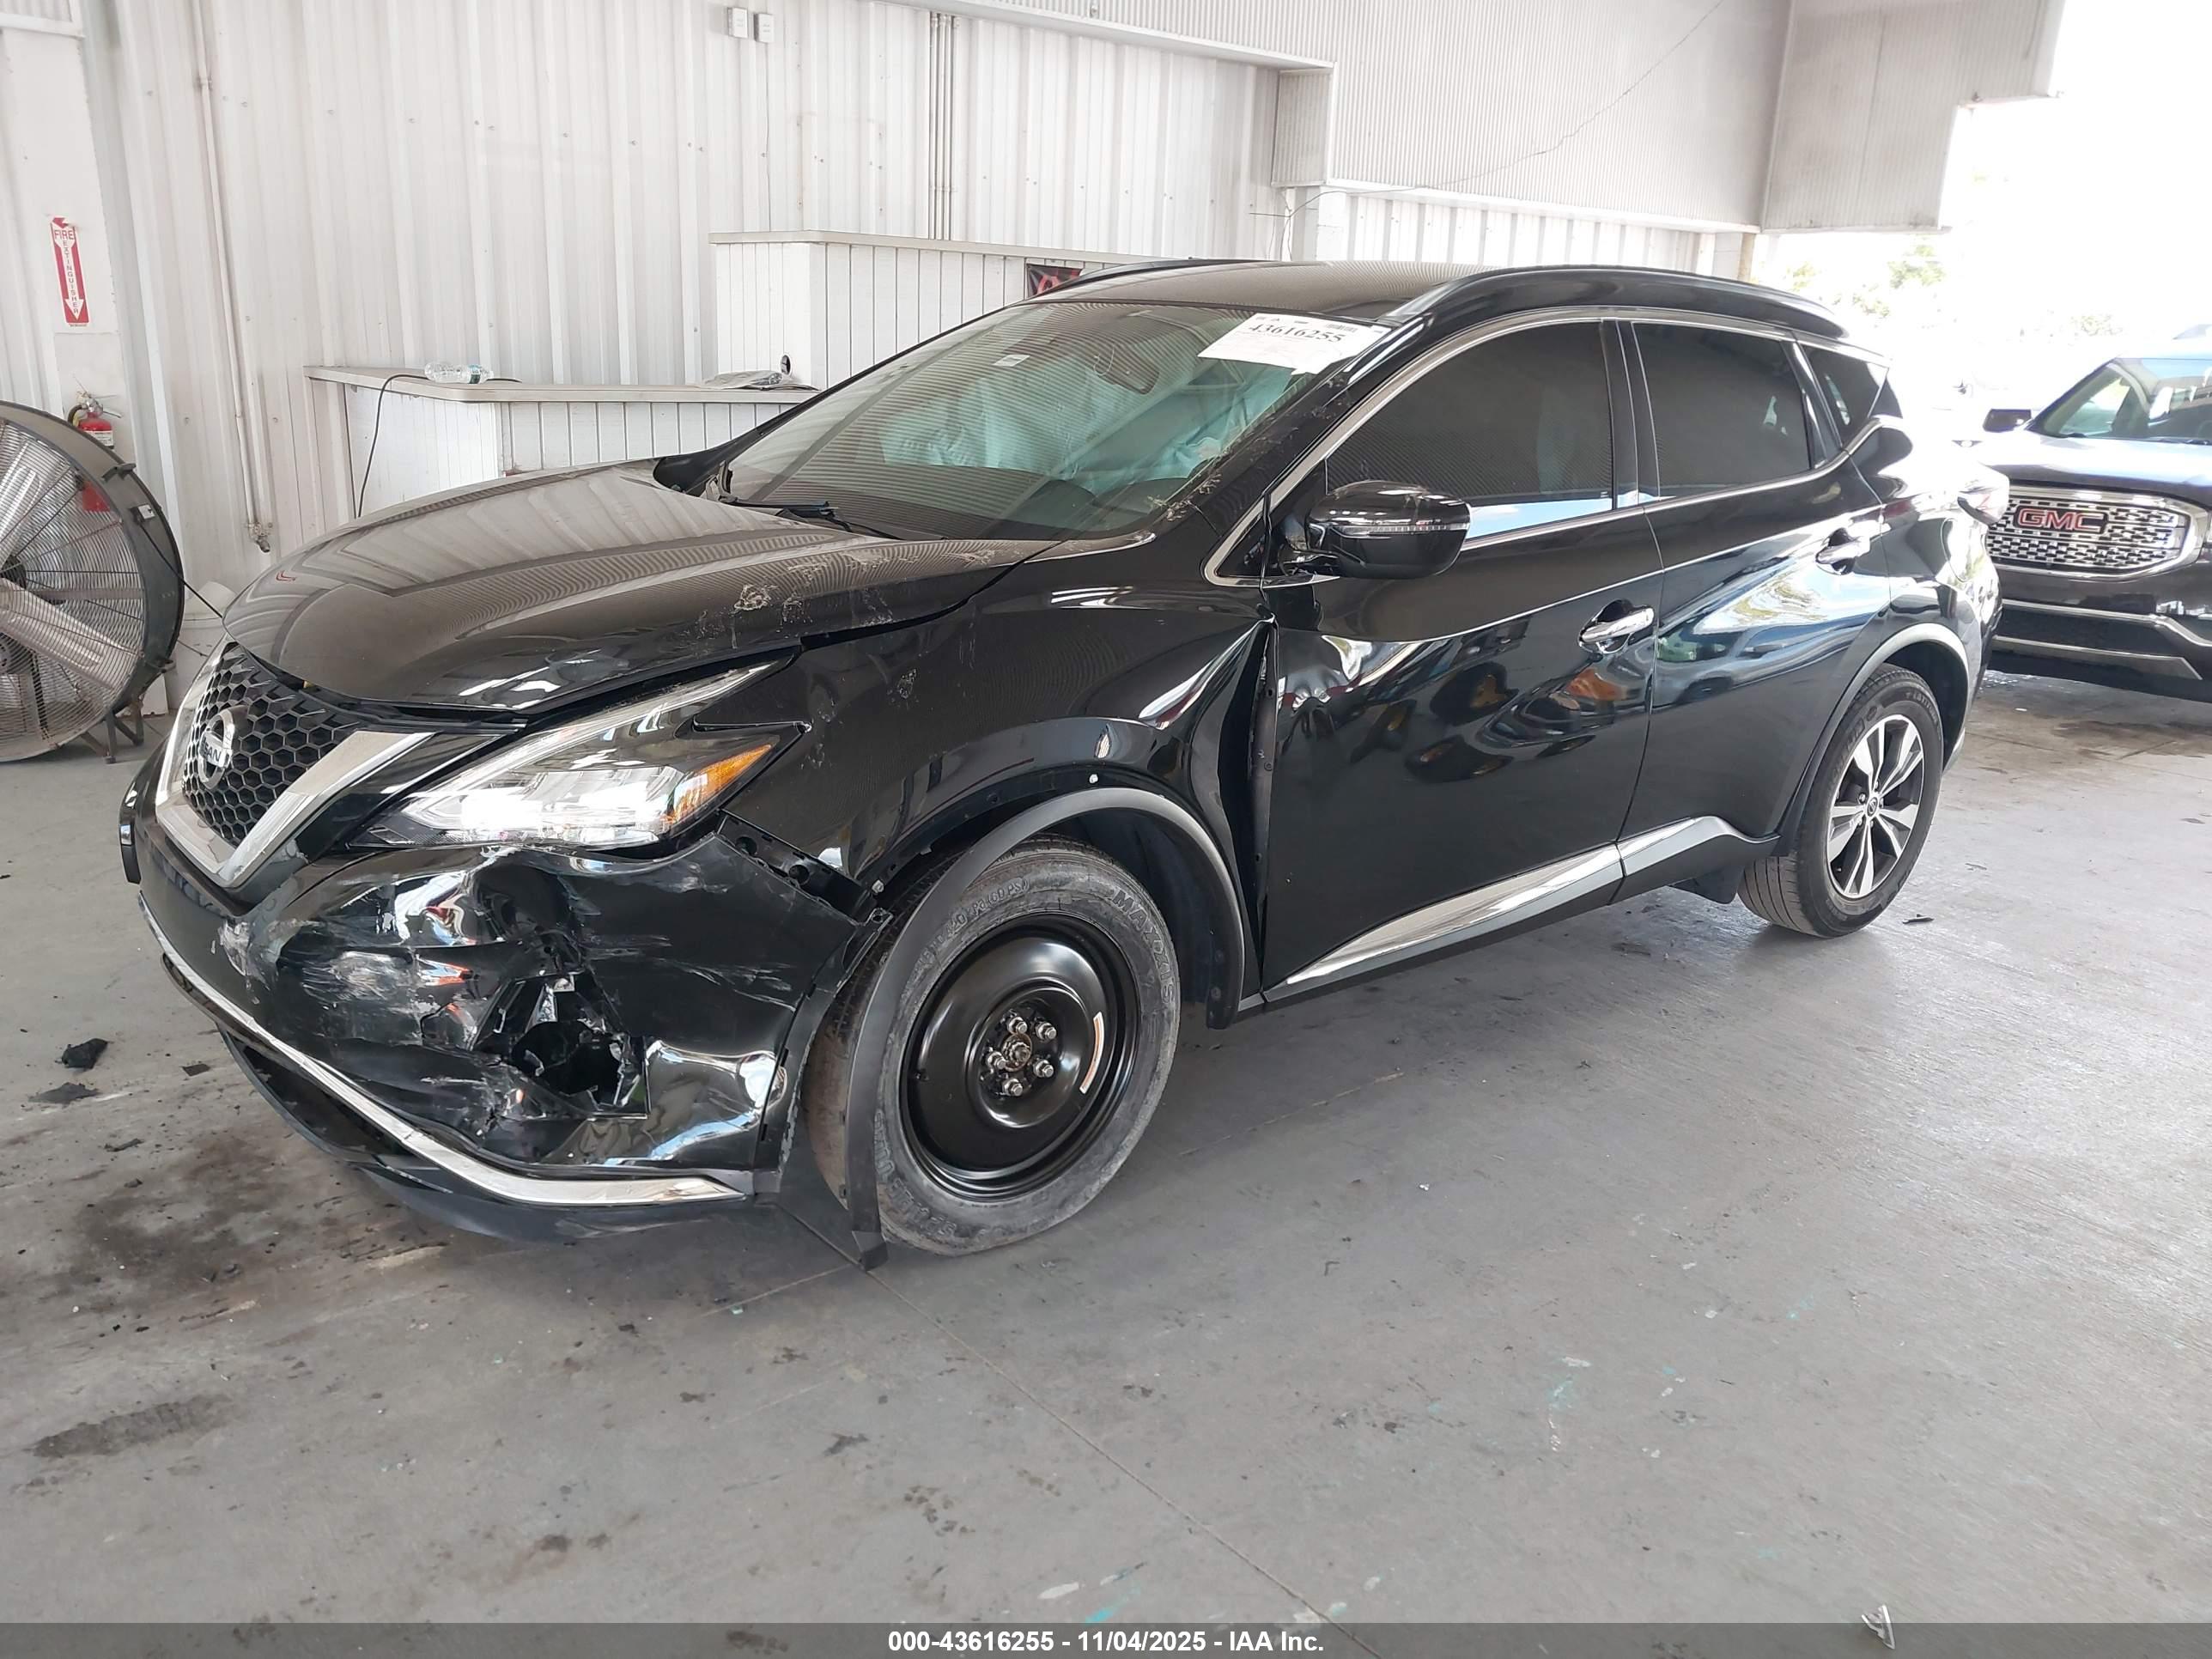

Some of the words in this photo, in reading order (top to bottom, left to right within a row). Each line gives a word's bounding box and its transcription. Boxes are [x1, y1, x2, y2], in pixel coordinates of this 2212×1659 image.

[54, 230, 75, 240] FIRE
[63, 240, 79, 314] EXTINGUISHER
[1249, 323, 1347, 343] 43616255
[2018, 507, 2106, 532] GMC
